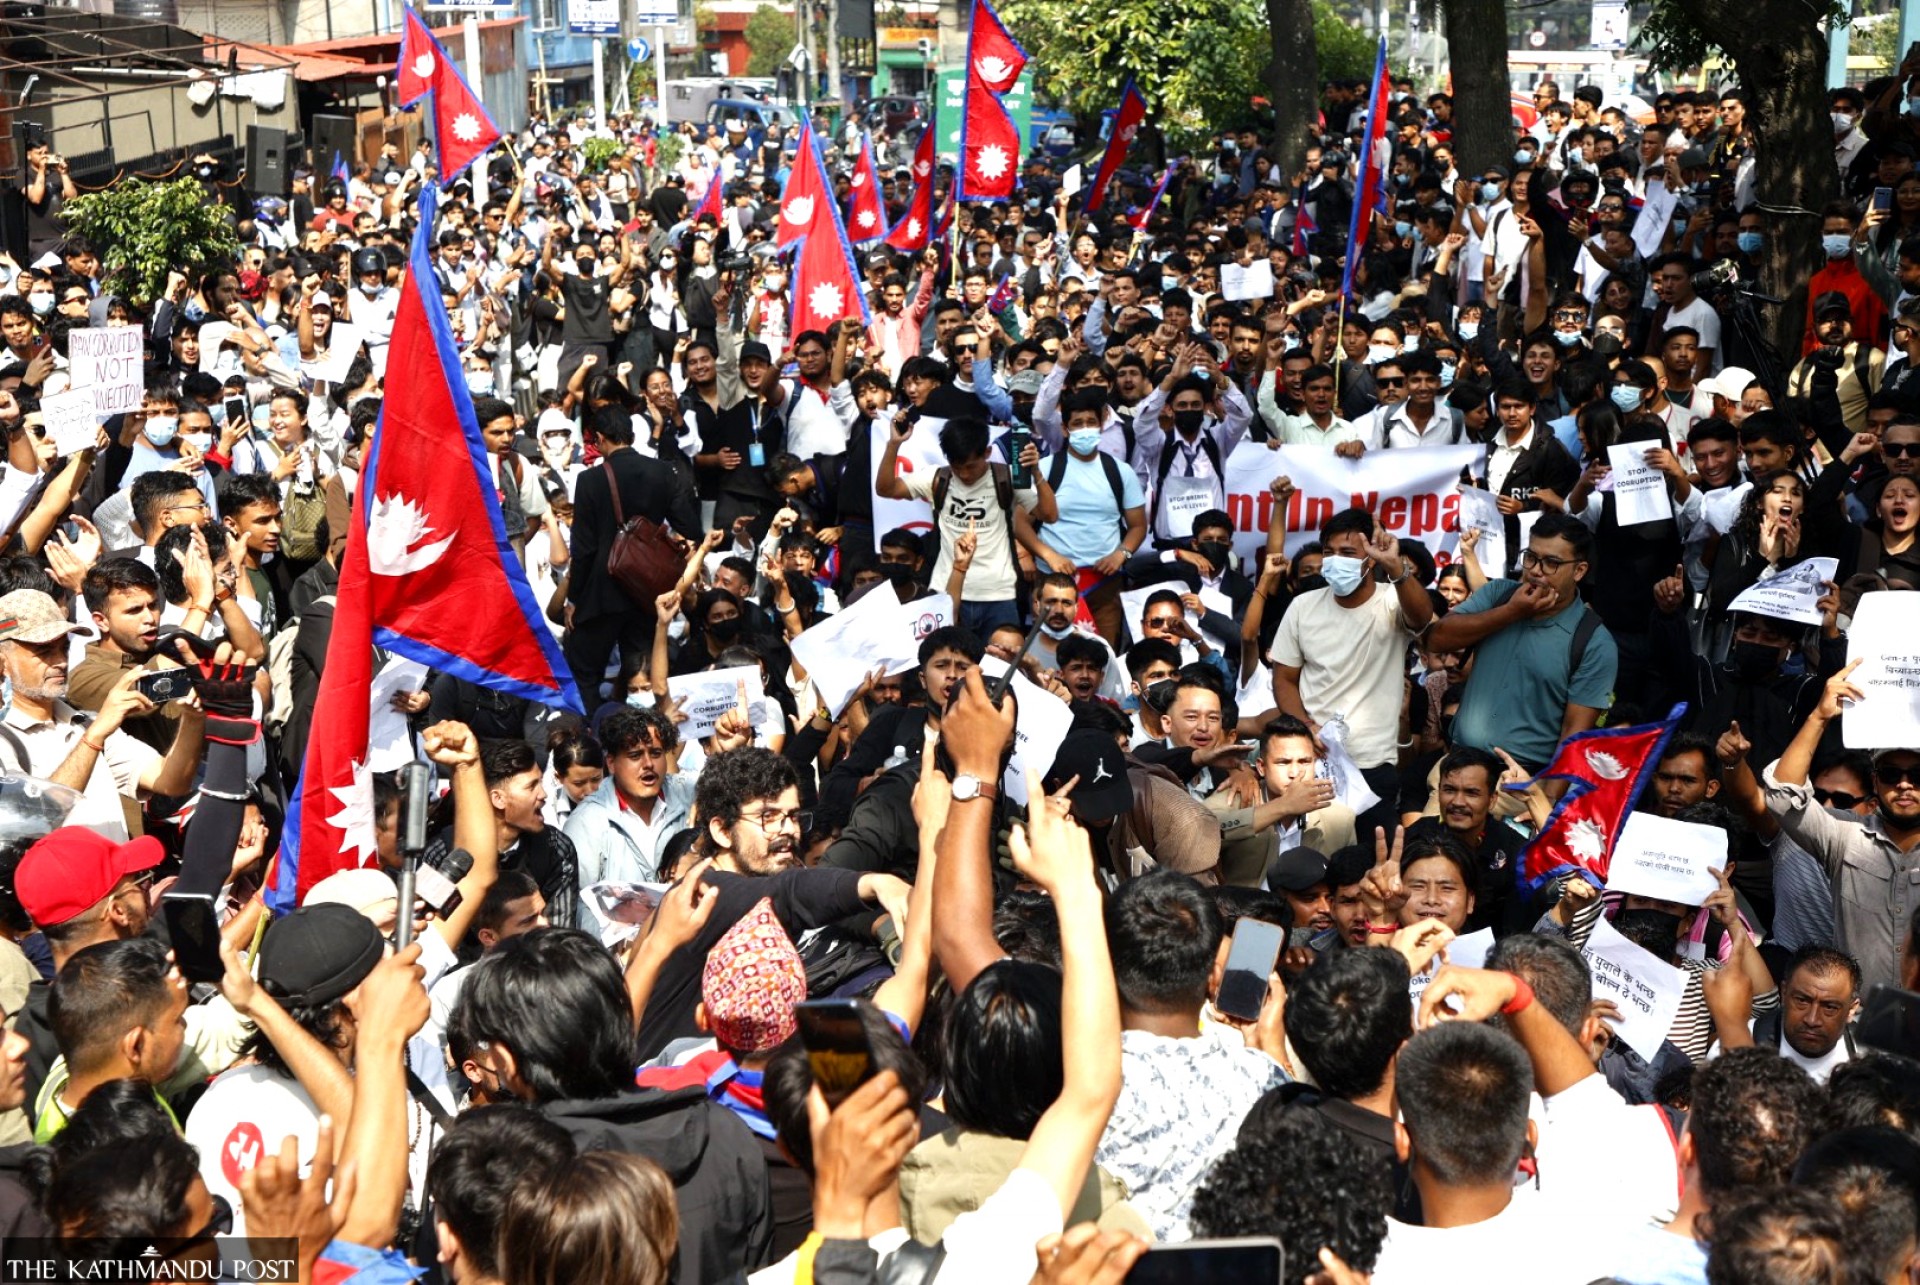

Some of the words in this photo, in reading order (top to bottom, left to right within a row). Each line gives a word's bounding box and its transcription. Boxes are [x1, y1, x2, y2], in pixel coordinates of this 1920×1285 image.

[94, 357, 134, 382] NOT
[1627, 468, 1648, 476] STOP
[1350, 491, 1461, 537] Nepa
[693, 702, 738, 714] CORRUPTIO
[1595, 955, 1622, 978] युवाले
[1623, 969, 1634, 984] के
[1622, 985, 1632, 1000] दे
